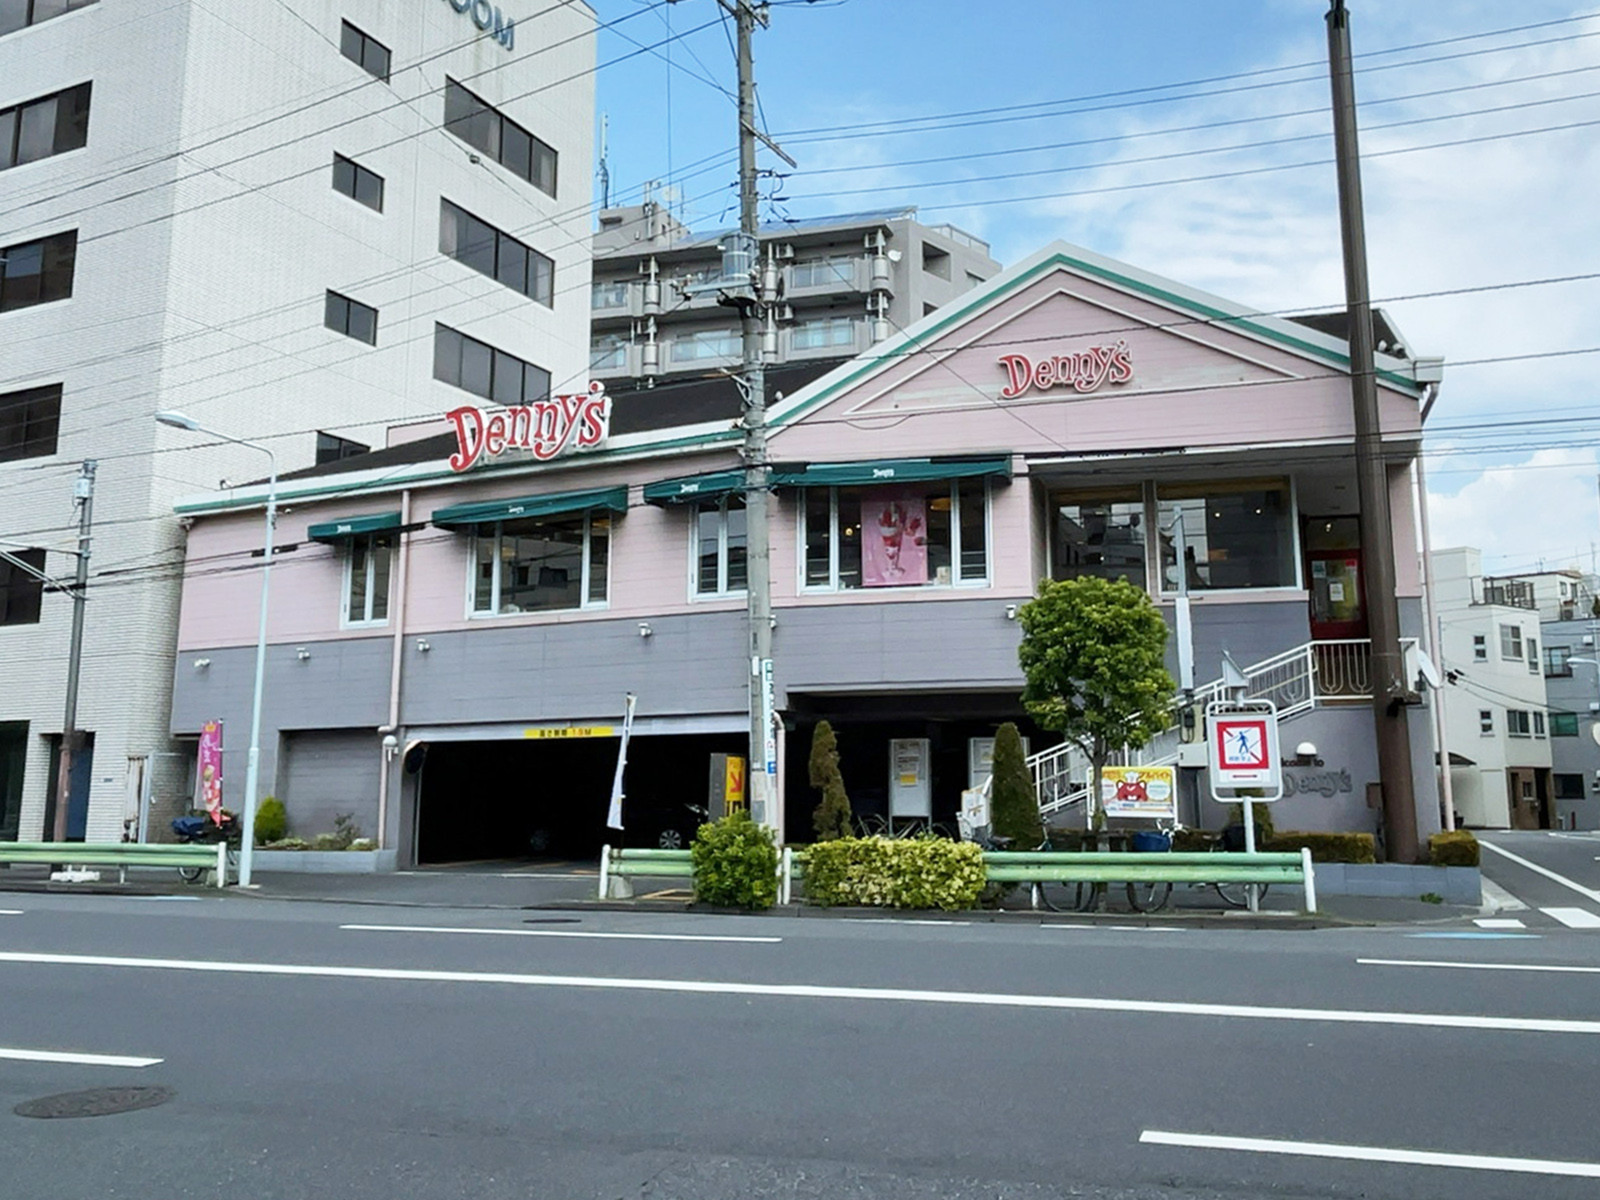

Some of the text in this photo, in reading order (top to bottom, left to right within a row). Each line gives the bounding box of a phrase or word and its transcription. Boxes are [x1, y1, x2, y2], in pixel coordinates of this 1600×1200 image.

[998, 338, 1133, 399] Denny's
[446, 380, 610, 472] Denny's
[1282, 767, 1354, 798] Denny's
